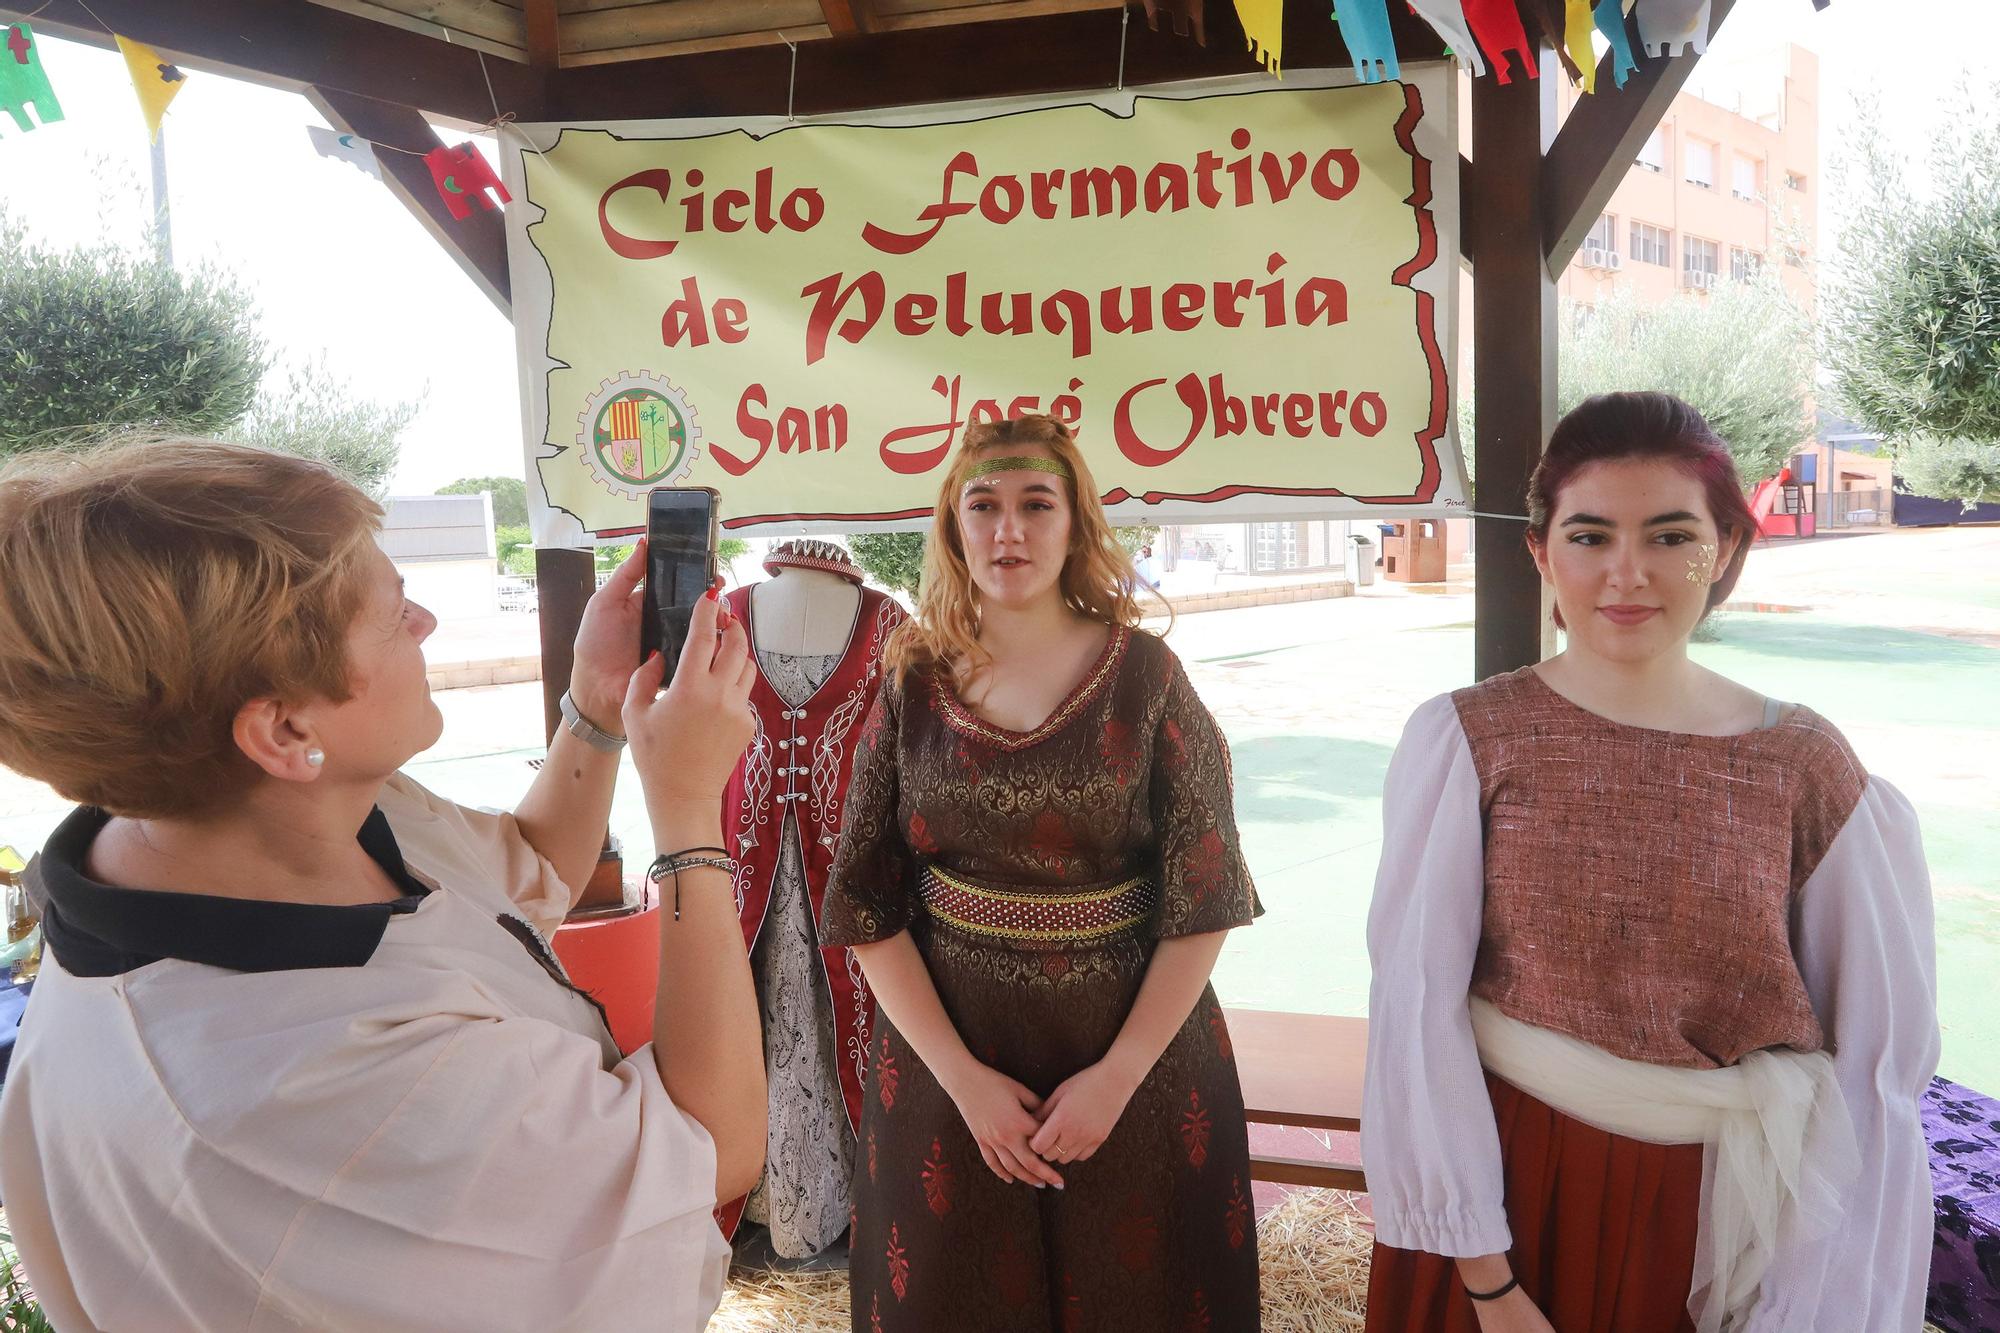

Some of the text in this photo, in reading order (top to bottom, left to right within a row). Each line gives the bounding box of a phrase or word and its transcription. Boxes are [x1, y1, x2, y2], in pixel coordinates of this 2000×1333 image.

[598, 127, 1360, 260] Ciclo Formativo
[662, 252, 1348, 366] de Peluquería
[708, 383, 848, 476] San
[1113, 372, 1388, 468] Obrero
